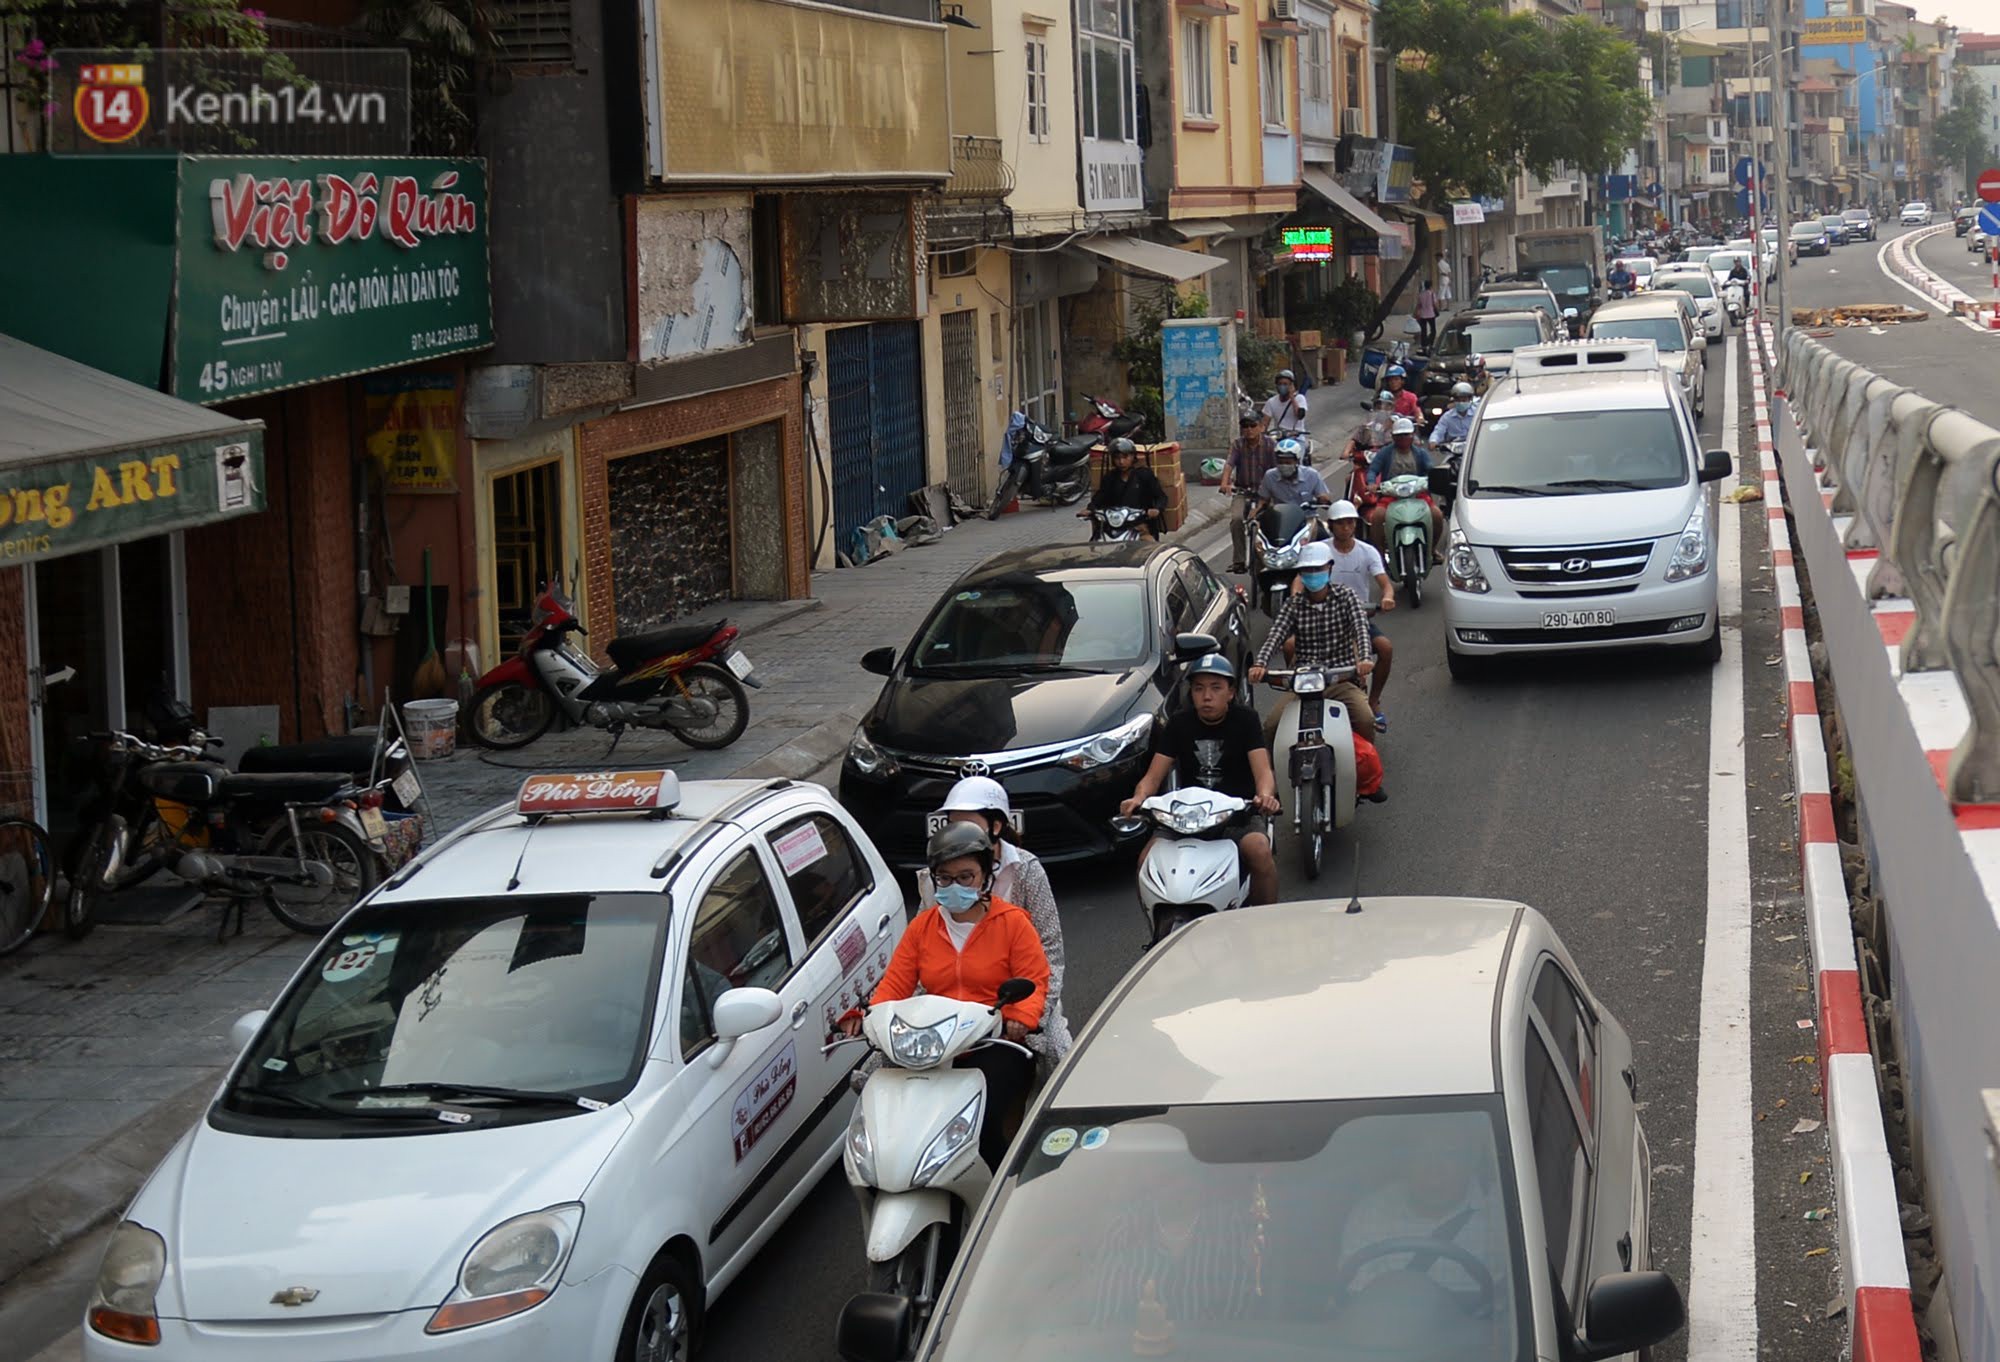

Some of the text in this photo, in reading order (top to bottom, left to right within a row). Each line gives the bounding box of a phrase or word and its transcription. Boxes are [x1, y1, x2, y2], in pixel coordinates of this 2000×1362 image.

[1089, 163, 1100, 200] 51
[210, 171, 475, 270] Việt Đô Quán
[329, 273, 356, 316] CÁC
[359, 267, 389, 309] MÓN
[411, 262, 436, 302] DÂN
[200, 361, 228, 393] 45
[86, 453, 180, 511] ART
[523, 778, 658, 806] Phù Đổng
[573, 773, 617, 781] TAXI
[326, 952, 377, 971] 127
